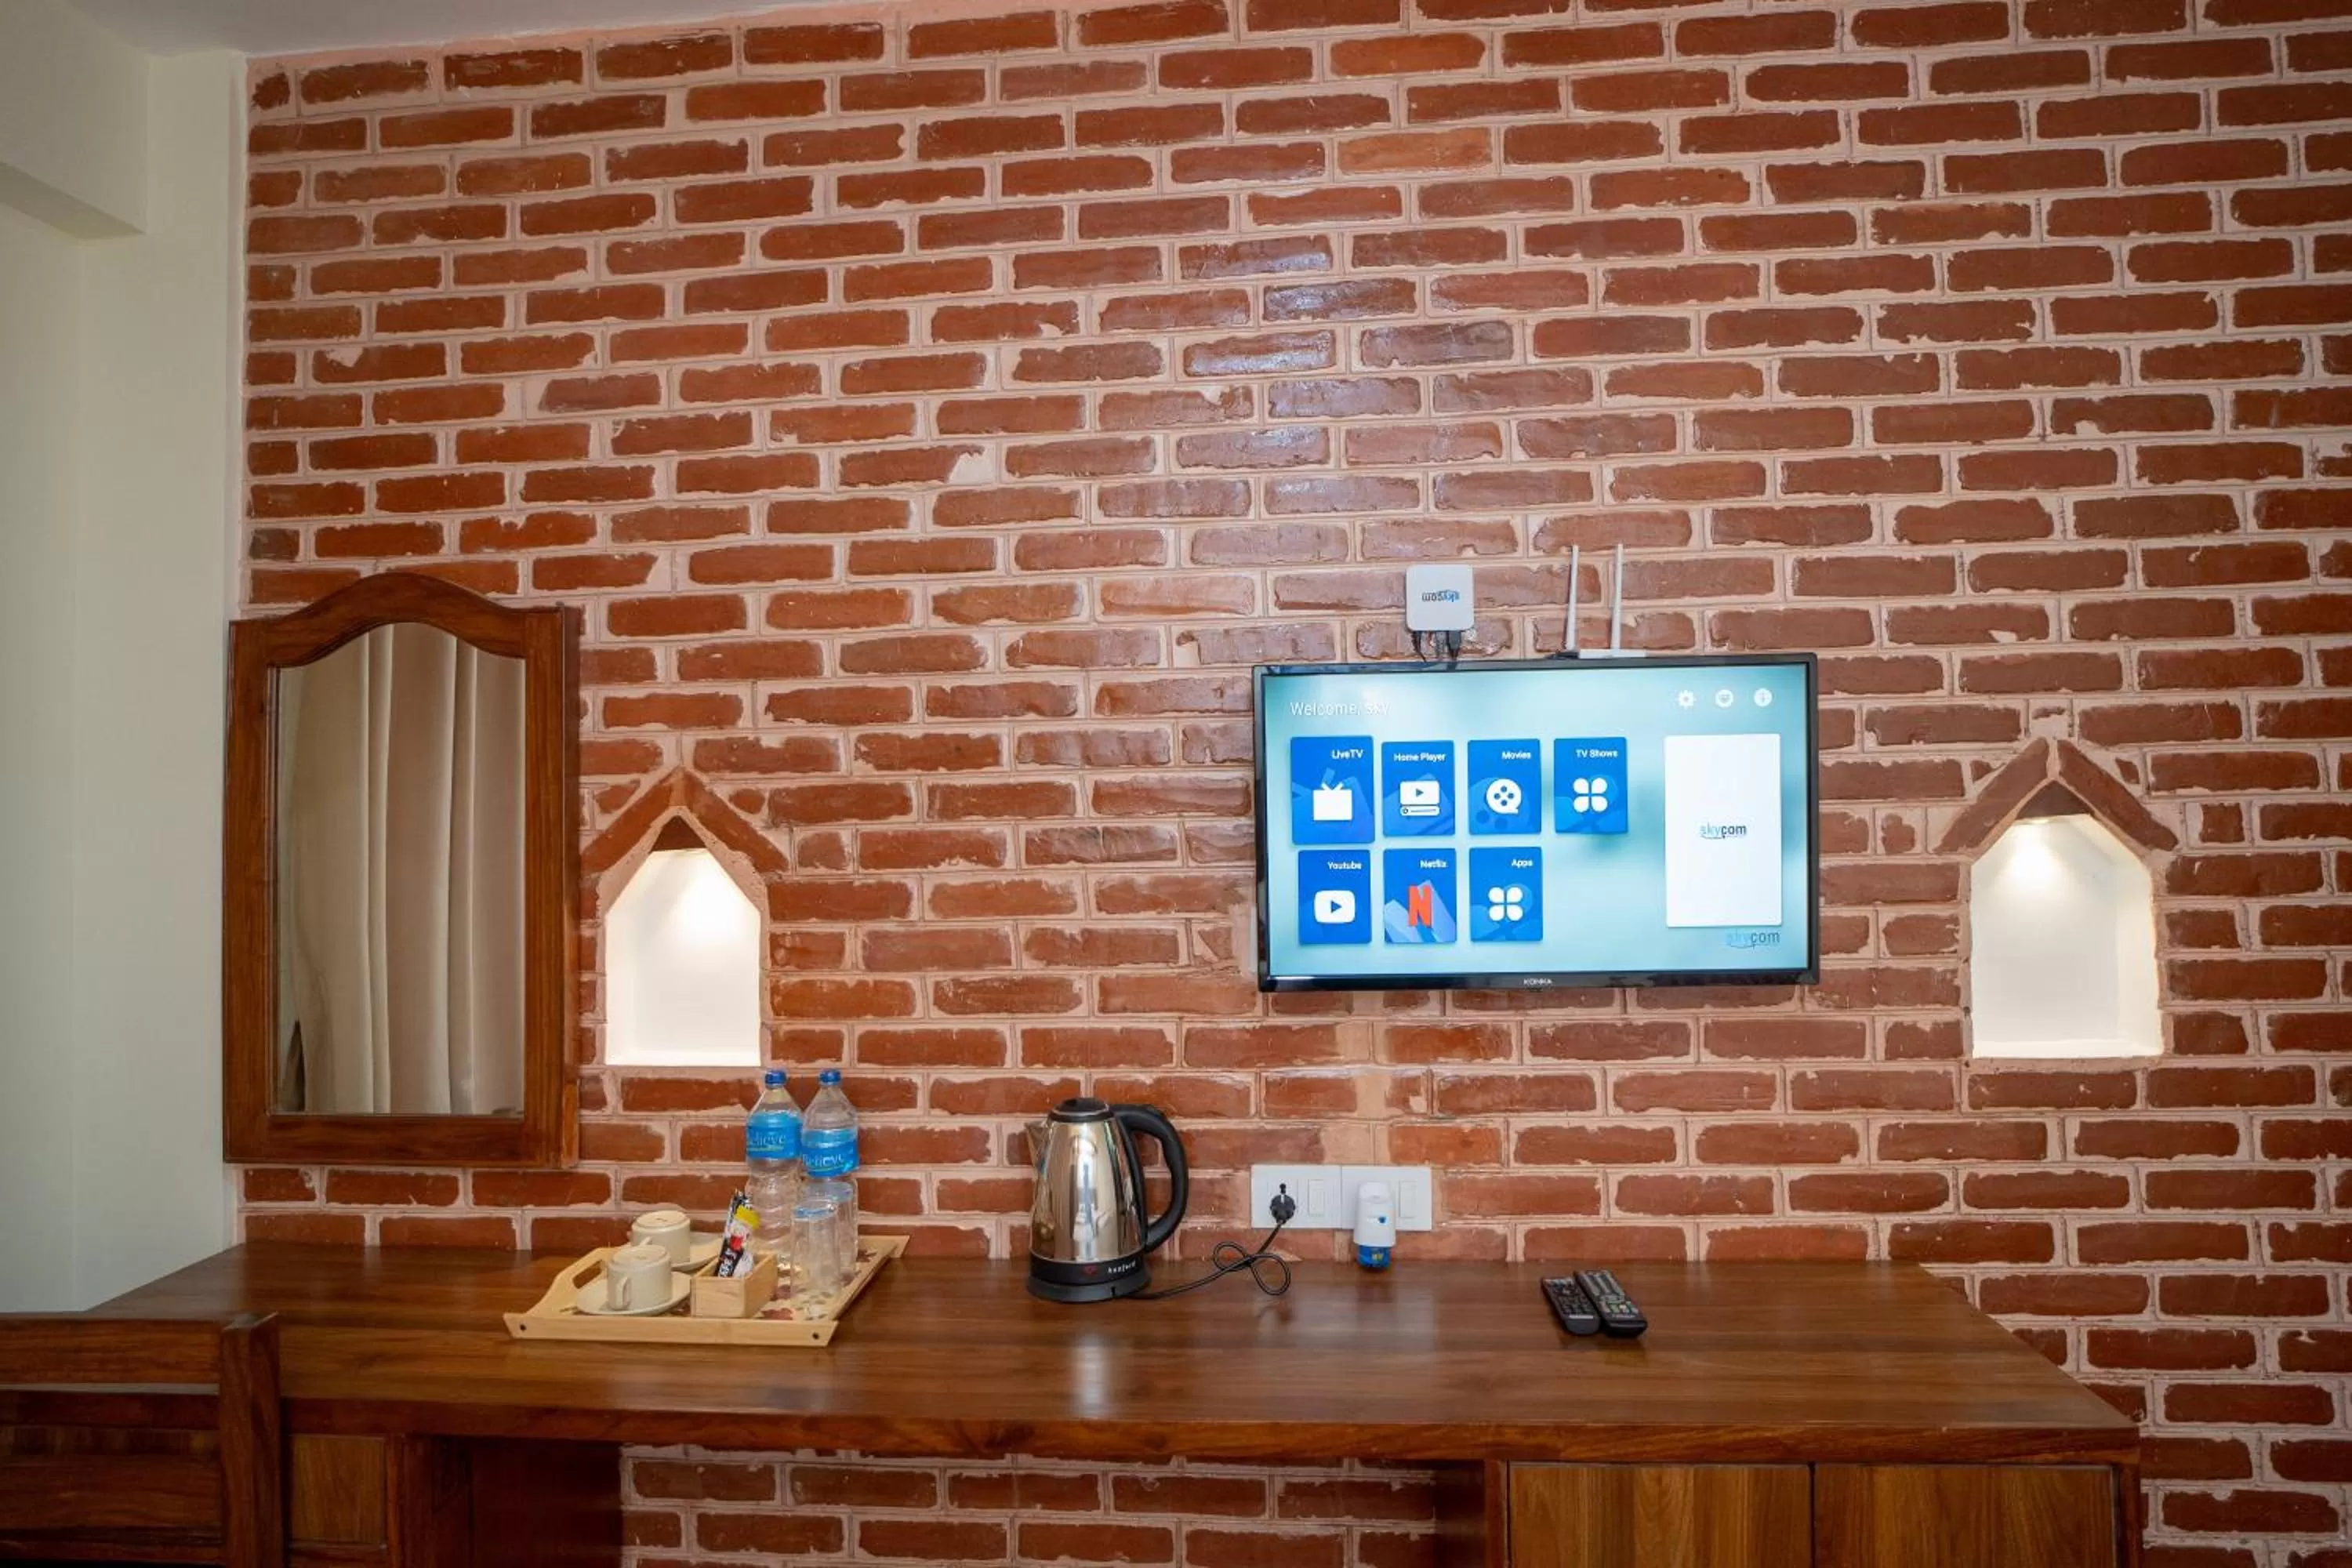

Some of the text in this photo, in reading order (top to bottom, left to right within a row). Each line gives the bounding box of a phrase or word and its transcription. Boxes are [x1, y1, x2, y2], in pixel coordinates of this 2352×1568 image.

[1331, 749, 1363, 760] LiveTV
[1393, 752, 1446, 763] Home Player
[1501, 750, 1532, 760] Movies
[1575, 749, 1618, 759] TV Shows
[1700, 822, 1747, 839] skycom
[1327, 861, 1362, 870] Youtube
[1420, 859, 1447, 869] Netflix
[1511, 858, 1533, 868] Apps
[1726, 928, 1780, 949] skycom
